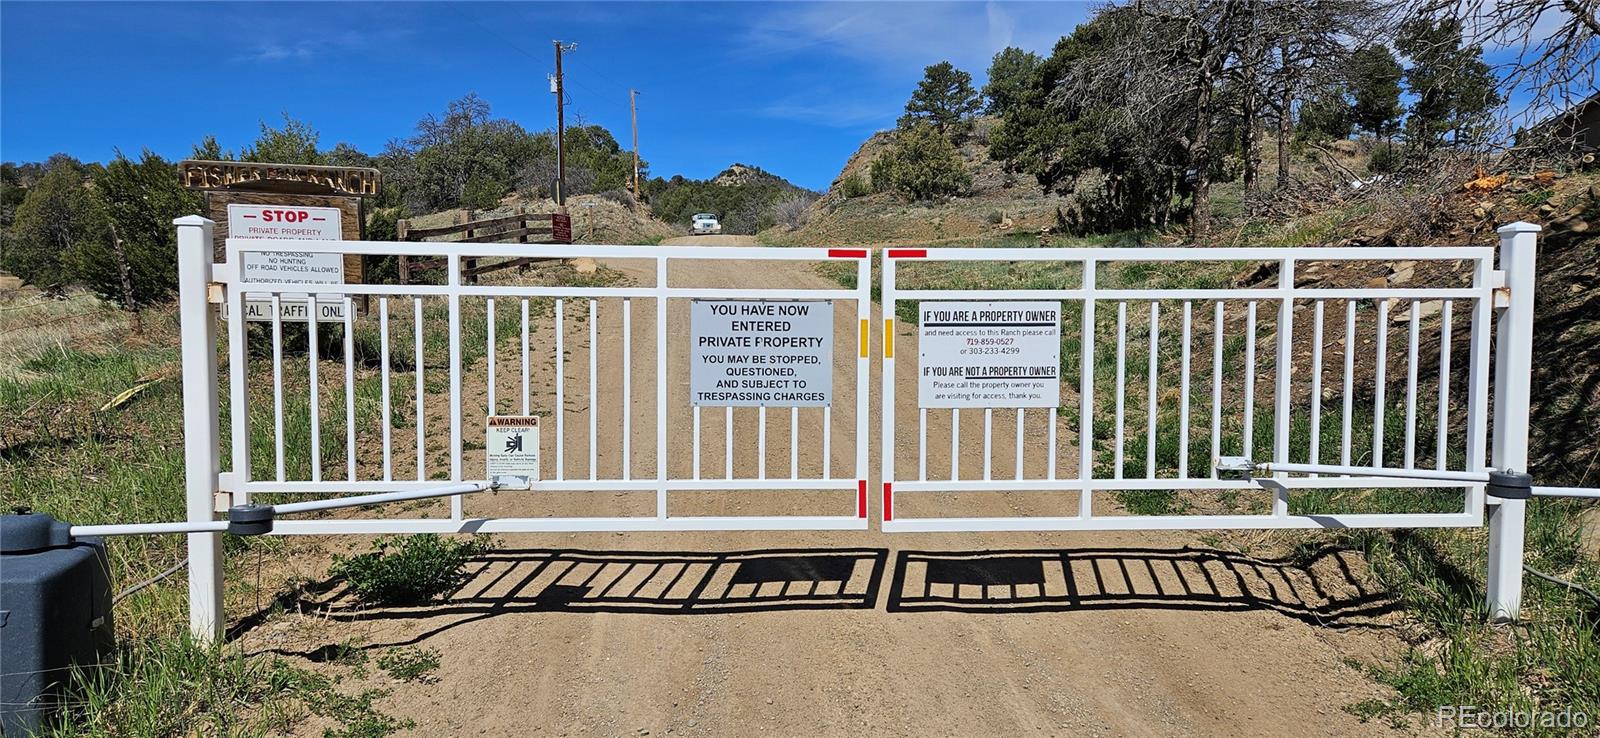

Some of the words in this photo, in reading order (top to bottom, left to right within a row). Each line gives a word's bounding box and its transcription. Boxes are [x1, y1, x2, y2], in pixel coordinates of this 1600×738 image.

[262, 209, 309, 223] STOP
[248, 226, 279, 235] PRIVATE
[281, 228, 322, 236] PROPERTY
[280, 265, 309, 273] VEHICLES
[310, 266, 339, 274] ALLOWED
[710, 304, 737, 316] YOU
[741, 305, 775, 316] HAVE
[778, 305, 809, 316] NOW
[923, 310, 932, 322] IF
[933, 310, 951, 322] YOU
[952, 310, 970, 322] ARE
[971, 310, 978, 322] A
[979, 310, 1024, 322] PROPERTY
[1025, 310, 1057, 322] OWNER
[731, 321, 791, 332] ENTERED
[987, 328, 999, 336] this
[1022, 329, 1044, 338] please
[698, 336, 751, 347] PRIVATE
[755, 336, 824, 348] PROPERTY
[966, 338, 1014, 346] 719-859-0527
[969, 347, 1020, 355] 303-233-4299
[702, 355, 725, 364] YOU
[727, 355, 750, 364] MAY
[752, 355, 767, 364] BE
[769, 355, 822, 365] STOPPED,
[725, 367, 797, 377] QUESTIONED,
[923, 366, 930, 376] IF
[932, 366, 947, 376] YOU
[948, 366, 964, 376] ARE
[965, 366, 980, 376] NOT
[981, 366, 988, 376] A
[988, 366, 1028, 376] PROPERTY
[1029, 366, 1057, 376] OWNER
[716, 380, 739, 389] AND
[741, 380, 789, 389] SUBJECT
[792, 380, 807, 389] TO
[933, 381, 955, 389] Please
[981, 381, 1010, 390] property
[1032, 382, 1045, 390] you
[697, 392, 771, 401] TRESPASSING
[773, 392, 825, 401] CHARGES
[946, 392, 971, 401] visiting
[971, 392, 982, 400] for
[1008, 392, 1027, 400] thank
[497, 418, 537, 426] WARNING
